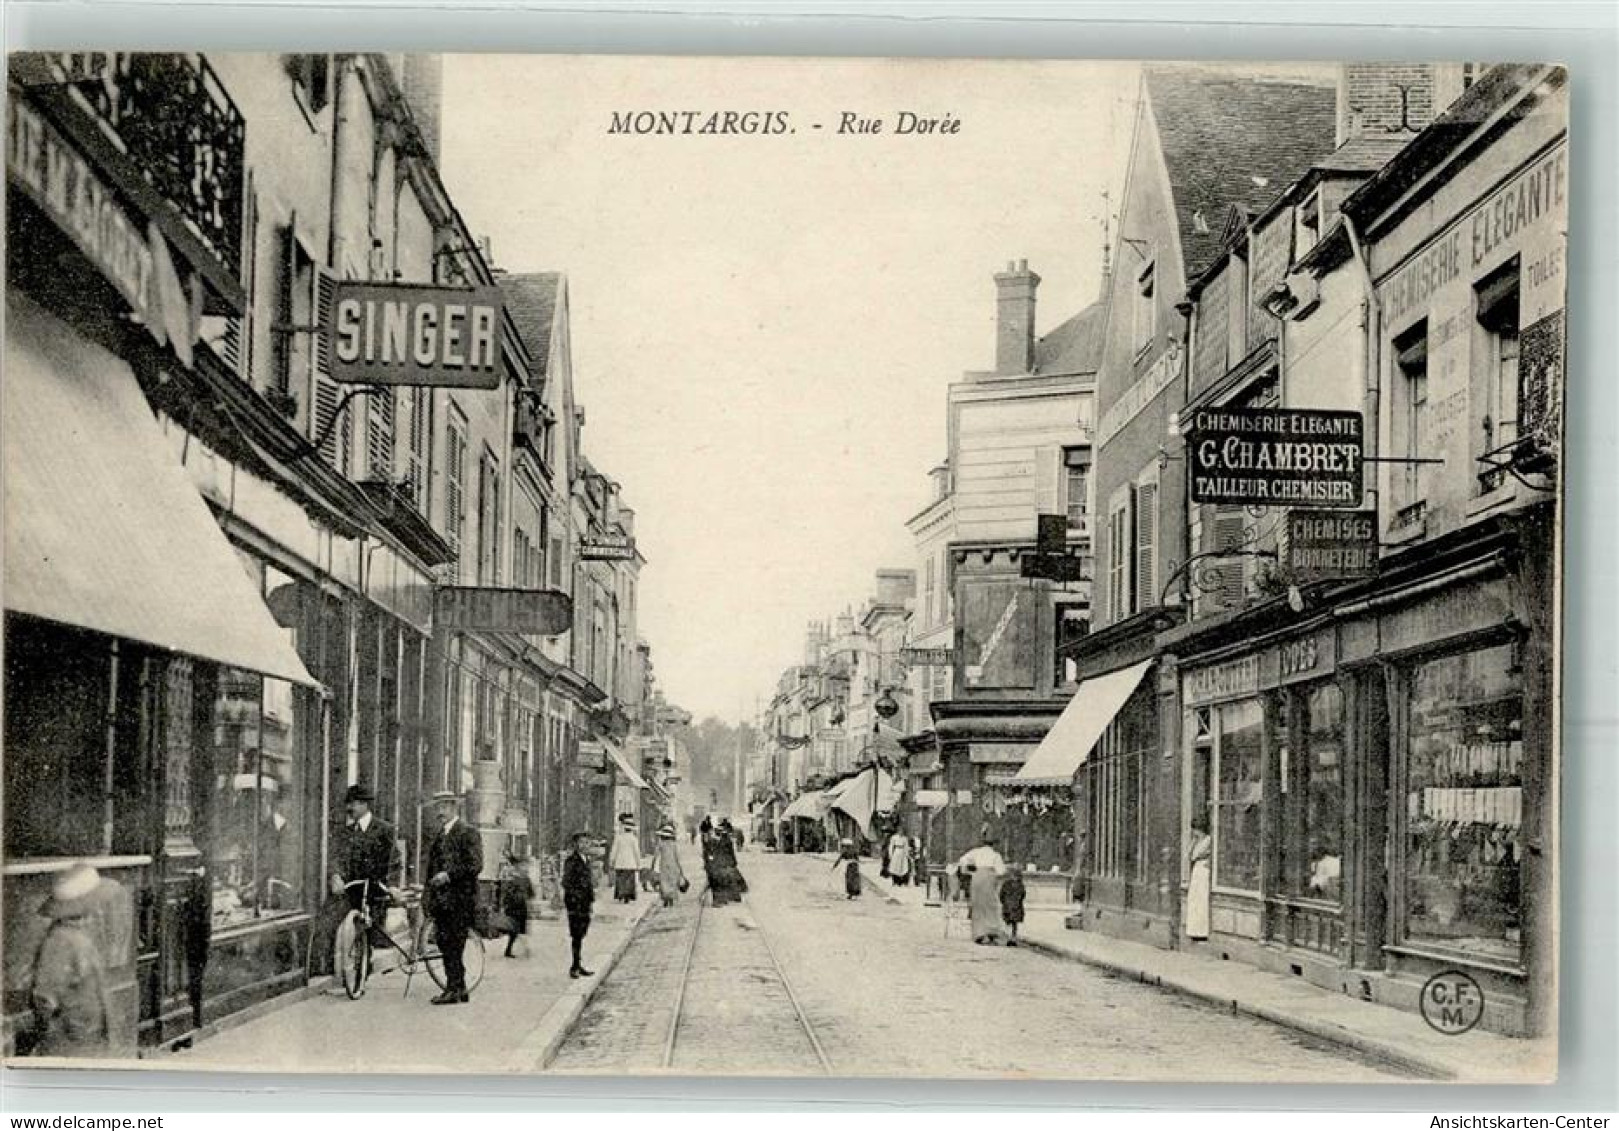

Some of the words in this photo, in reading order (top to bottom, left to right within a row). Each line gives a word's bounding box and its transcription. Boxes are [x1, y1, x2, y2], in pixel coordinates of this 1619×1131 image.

[1472, 151, 1564, 267] ELEGANTE
[336, 299, 495, 370] SINGER
[1195, 411, 1287, 434] CHEMISERIE
[1291, 414, 1359, 436] ELEGANTE
[1222, 435, 1360, 473] CHAMBRET
[1196, 477, 1268, 497] TAILLEUR
[1271, 479, 1354, 500] CHEMISIER
[1293, 517, 1372, 540] CHEMISES
[1293, 548, 1374, 568] BONNETERIE
